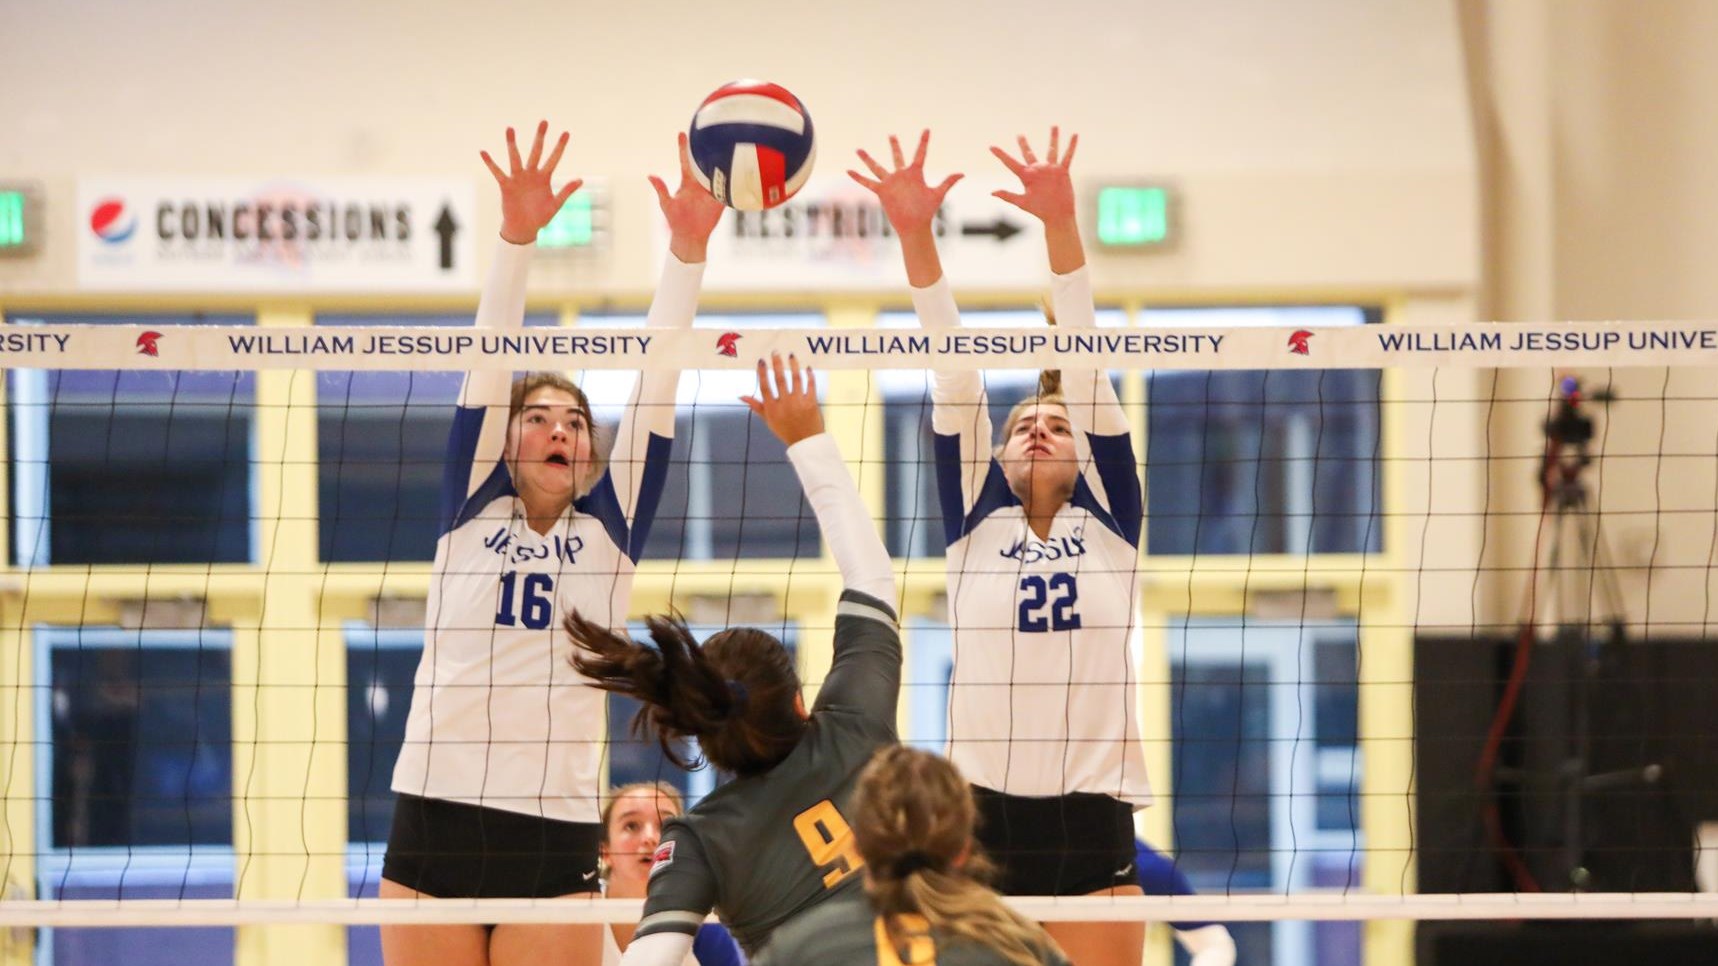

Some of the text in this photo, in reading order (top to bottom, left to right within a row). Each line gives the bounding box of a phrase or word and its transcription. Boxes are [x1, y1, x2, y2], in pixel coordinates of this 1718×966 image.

[156, 201, 412, 241] CONCESSIONS
[733, 203, 952, 239] RESTROS
[0, 333, 70, 352] SITY
[228, 335, 651, 354] WILLIAM JESSUP UNIVERSITY
[806, 334, 1224, 354] WILLIAM JESSUP UNIVERSITY
[1378, 330, 1717, 351] WILLIAM JESSUP UNIVE
[495, 569, 554, 630] 16
[1018, 572, 1081, 633] 22
[793, 798, 864, 890] 9
